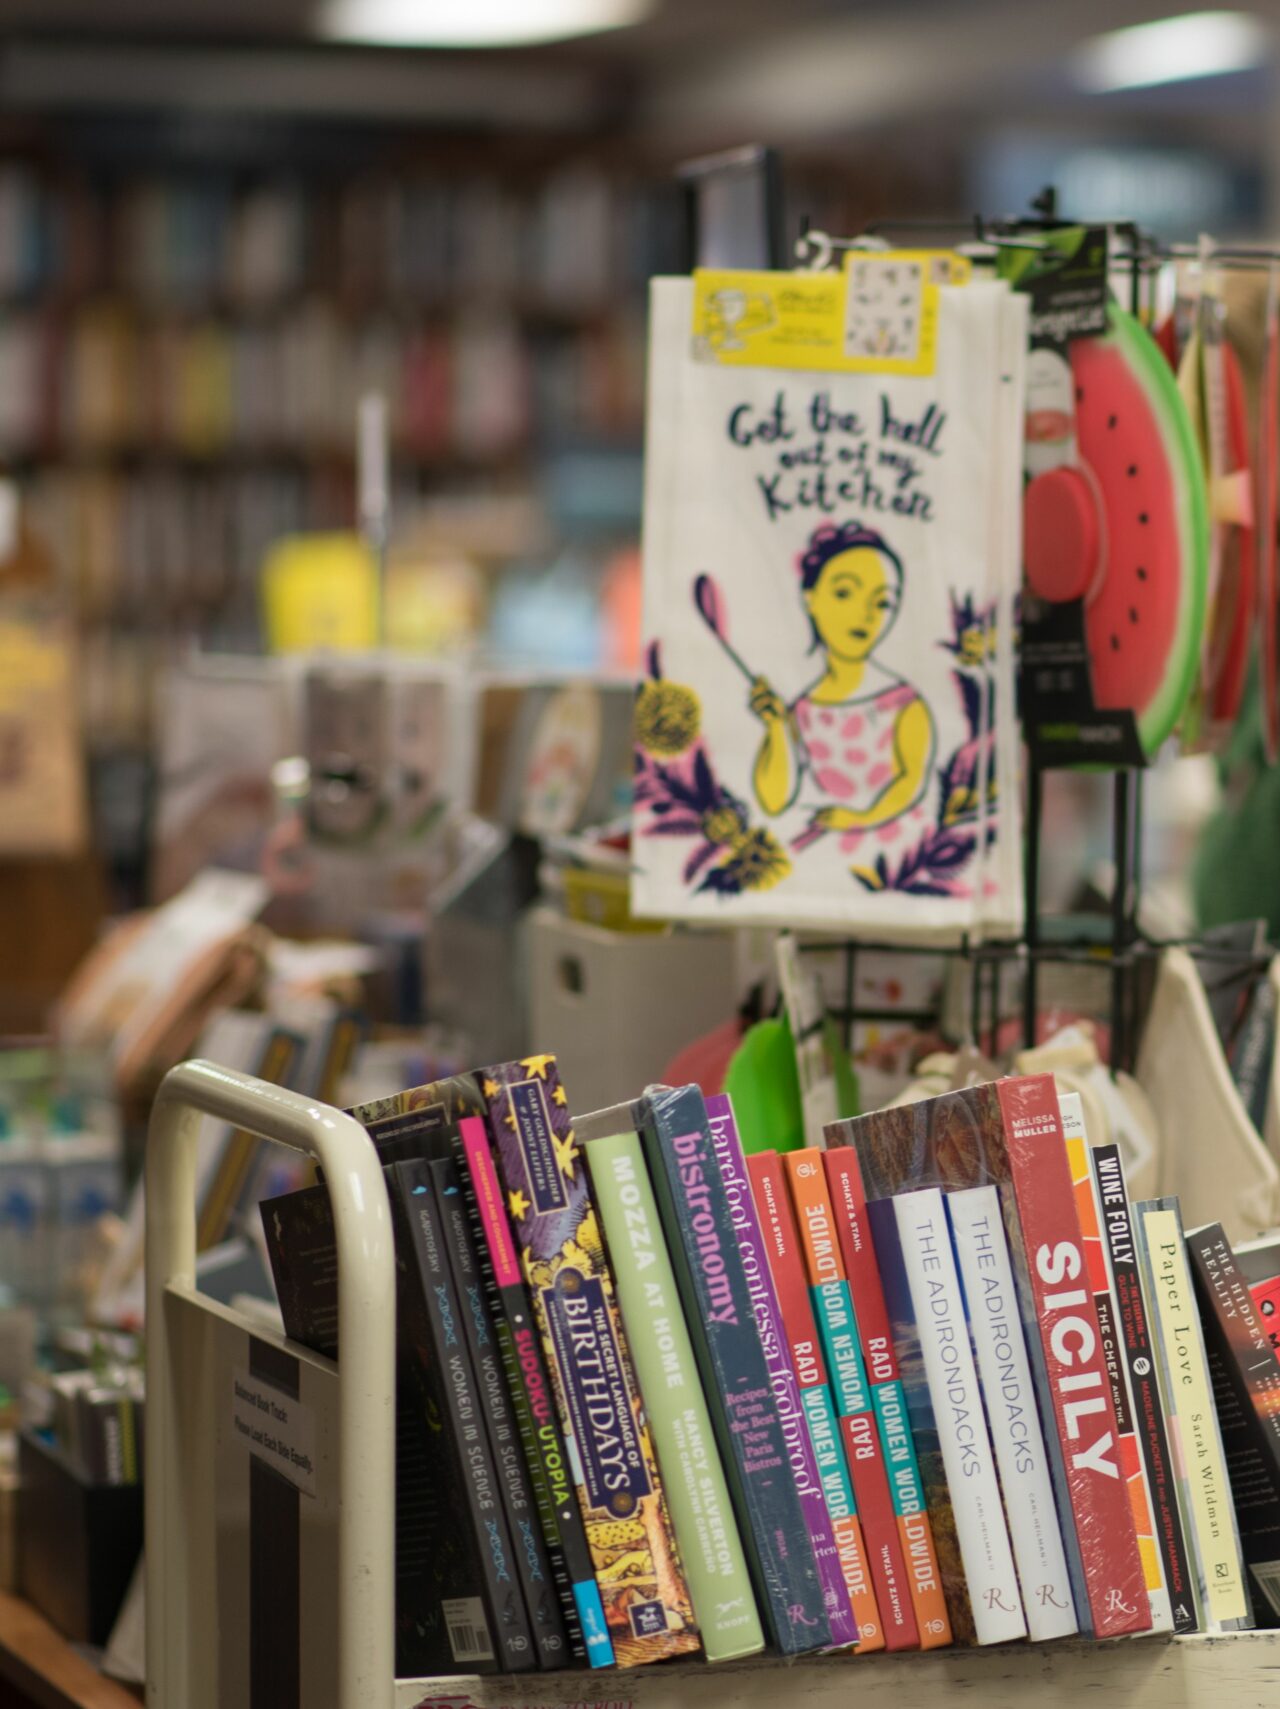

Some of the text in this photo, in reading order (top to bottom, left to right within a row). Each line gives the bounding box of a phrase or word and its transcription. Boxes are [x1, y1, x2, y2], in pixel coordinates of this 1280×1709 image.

[728, 391, 946, 456] Get the hell
[756, 470, 934, 521] Kitchen
[520, 1116, 547, 1191] JOOST ELFFERS
[525, 1087, 562, 1203] GARY GOLDSCHNEIDER
[1012, 1114, 1055, 1128] MELISSA
[1014, 1124, 1057, 1138] MULLER
[418, 1208, 441, 1274] IGNOTOFSKY
[449, 1209, 472, 1274] IGNOTOFSKY
[672, 1131, 738, 1326] bistronomy
[760, 1176, 786, 1257] SCHATZ STAHL
[839, 1171, 863, 1252] SCHATZ STAHL
[1096, 1155, 1135, 1266] WINE FOLLY
[611, 1153, 684, 1389] MOZZA AT HOME
[707, 1112, 821, 1503] barefoot contessa foolproof
[1116, 1273, 1137, 1349] GUIDE TO WINE
[1129, 1285, 1146, 1334] THE ESSENTIAL
[1154, 1241, 1199, 1387] Paper Love
[1197, 1246, 1238, 1321] REALITY
[1210, 1239, 1266, 1352] THE HIDDEN
[792, 1340, 819, 1384] RAD
[804, 1202, 875, 1460] RAD WOMEN WORLDWIDE
[914, 1218, 981, 1478] THE ADIRONDACKS
[969, 1215, 1035, 1474] THE ADIRONDACKS
[1036, 1241, 1119, 1480] SICILY
[1095, 1304, 1125, 1423] THE CHEF AND THE
[447, 1354, 493, 1510] WOMEN IN SCIENCE
[480, 1355, 526, 1510] WOMEN IN SCIENCE
[513, 1326, 571, 1506] SUDOKU-UTOPIA
[560, 1293, 632, 1492] BIRTHDAYS
[592, 1306, 640, 1469] THE SECRET LANGUAGE OF
[725, 1385, 768, 1406] Recipes
[728, 1412, 775, 1433] the Best
[734, 1400, 764, 1417] from
[742, 1428, 769, 1444] New
[802, 1388, 838, 1467] WOMEN
[671, 1418, 703, 1515] WITH CAROLYNN
[681, 1408, 735, 1577] NANCY SILVERTON
[743, 1453, 782, 1473] Bistros
[744, 1441, 774, 1458] Paris
[867, 1336, 937, 1593] RAD WOMEN WORLDWIDE
[1139, 1379, 1183, 1593] MADELINE PUCKETTE JUSTIN HAMMACK
[1190, 1412, 1222, 1539] Sarah Wildman
[821, 1471, 867, 1598] WORLDWIDE
[714, 1613, 751, 1630] KNOPF
[879, 1543, 904, 1624] SCHATZ STAHL
